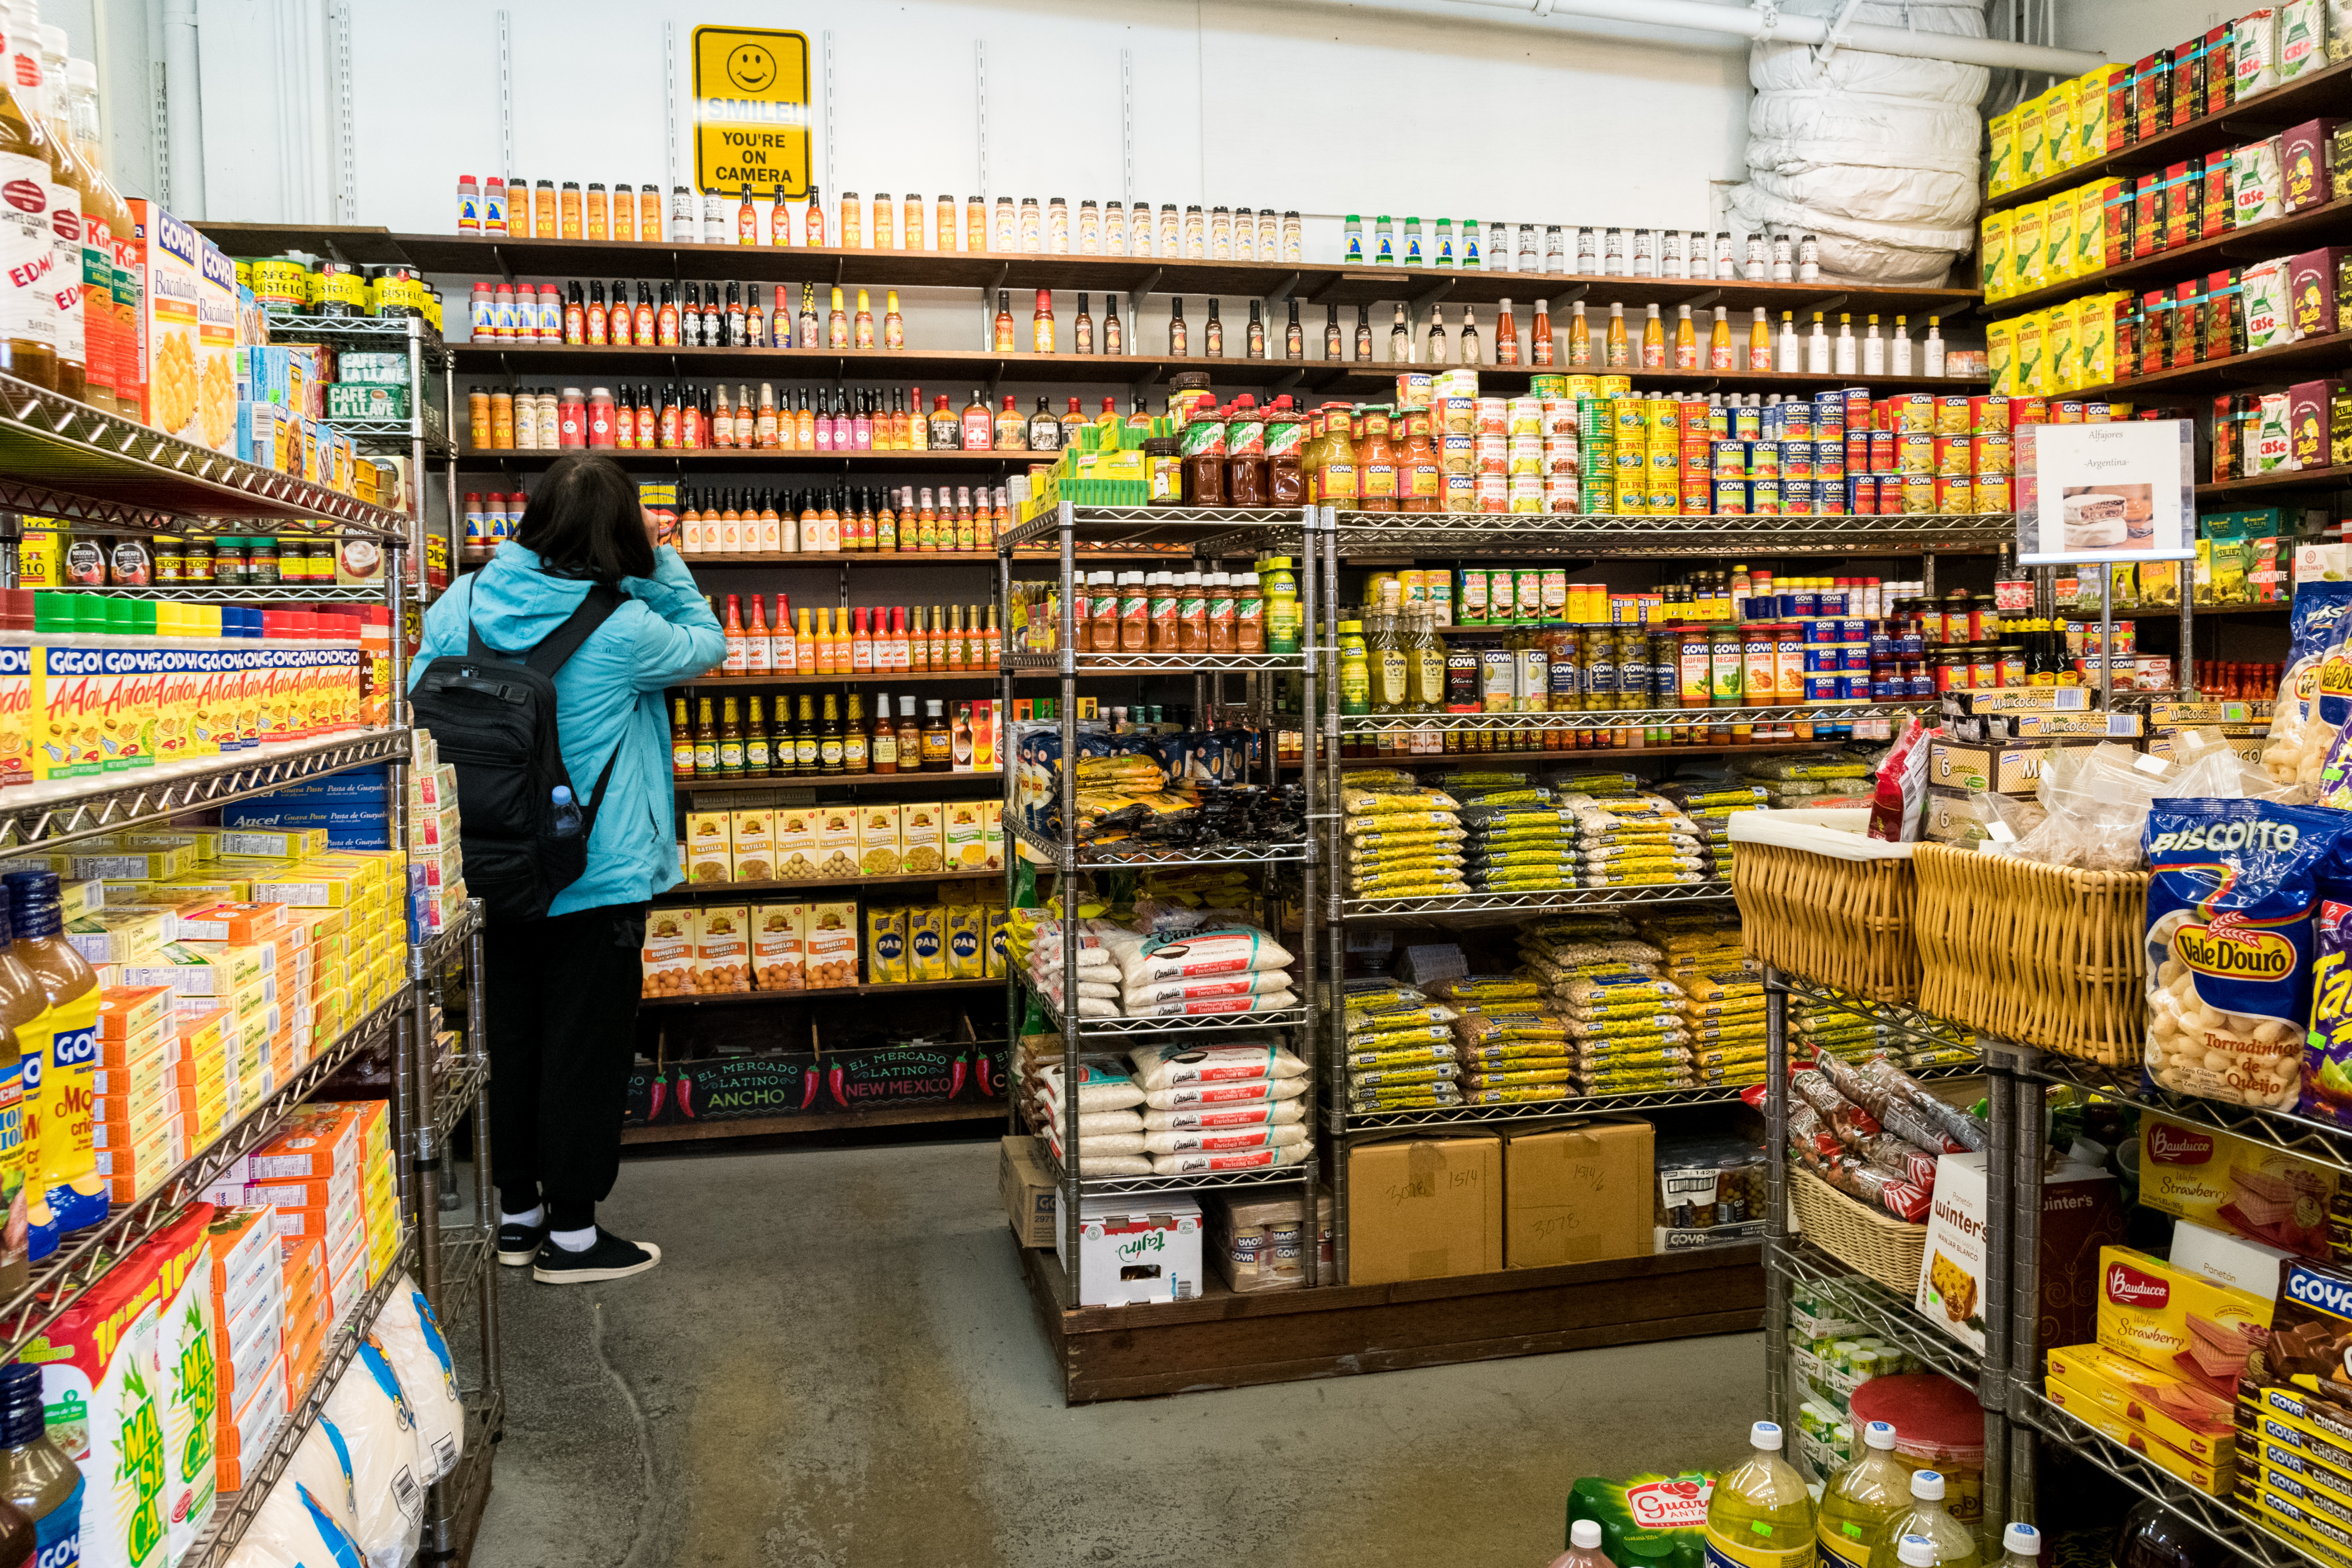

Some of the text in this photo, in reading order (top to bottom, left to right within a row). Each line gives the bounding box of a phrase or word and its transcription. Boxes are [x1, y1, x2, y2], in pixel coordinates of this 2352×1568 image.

[708, 98, 797, 121] SMILE!
[722, 132, 785, 147] YOU'RE
[742, 150, 766, 164] ON
[716, 166, 792, 183] CAMERA
[160, 217, 194, 260] GOYA
[204, 249, 232, 291] GOYA
[255, 282, 303, 295] BUSTELO
[382, 290, 422, 301] BUSTELO
[342, 355, 376, 367] CAFE
[342, 368, 404, 381] LA LLAVE
[330, 389, 365, 402] CAFE
[1911, 396, 1932, 404] GOYA
[332, 403, 394, 415] LA LLAVE
[1448, 399, 1472, 409] GOYA
[1786, 404, 1810, 413] GOYA
[275, 405, 287, 421] GOYA
[2089, 430, 2123, 441] Alfajores
[2248, 570, 2288, 583] ROSAMONTE
[1682, 645, 1709, 654] GOYA
[1714, 644, 1740, 654] GOYA
[1449, 658, 1476, 667] GOYA
[1485, 654, 1511, 663] GOYA
[1941, 757, 1951, 777] 6
[233, 815, 280, 827] Ancel
[2151, 822, 2299, 853] BISCOITO
[696, 844, 722, 852] NATILLA
[763, 909, 793, 926] MOUNTAIN
[652, 946, 684, 958] BUÑUELOS
[763, 941, 794, 952] BUÑUELOS
[2180, 935, 2214, 965] Vale
[1155, 968, 1179, 980] Canilla
[2205, 1032, 2300, 1056] Torradinhos
[851, 1052, 946, 1071] EL MERCADO
[2181, 1065, 2195, 1074] Zero
[2242, 1058, 2260, 1074] de
[698, 1061, 798, 1083] EL MERCADO
[870, 1065, 927, 1076] LATINO
[720, 1076, 778, 1088] LATINO
[846, 1078, 951, 1097] NEW MEXICO
[2198, 1082, 2239, 1098] Conservantes
[2227, 1073, 2280, 1095] Queijo
[709, 1090, 784, 1108] ANCHO
[2151, 1127, 2209, 1158] Bauducco
[1183, 1159, 1207, 1171] Canilla
[2176, 1171, 2198, 1182] Wafer
[2161, 1177, 2228, 1203] Strawberry
[1952, 1192, 1973, 1209] Panetón
[1935, 1199, 1986, 1243] winter's
[1671, 1234, 1705, 1245] GOYA
[1938, 1233, 1978, 1261] MANJAR BLANCO
[1231, 1251, 1254, 1261] GOYA
[2204, 1262, 2236, 1283] Panetón
[2110, 1267, 2166, 1302] Bauducco
[2290, 1274, 2352, 1316] GOYA
[2134, 1313, 2155, 1326] Wafer
[2118, 1318, 2184, 1347] Strawberry
[2270, 1392, 2304, 1418] GOYA
[2267, 1421, 2300, 1447] GOYA
[2311, 1443, 2352, 1471] CHOCOL
[2313, 1470, 2352, 1498] CHOCOL
[1638, 1496, 1709, 1519] Guar
[2266, 1495, 2300, 1521] GOYA
